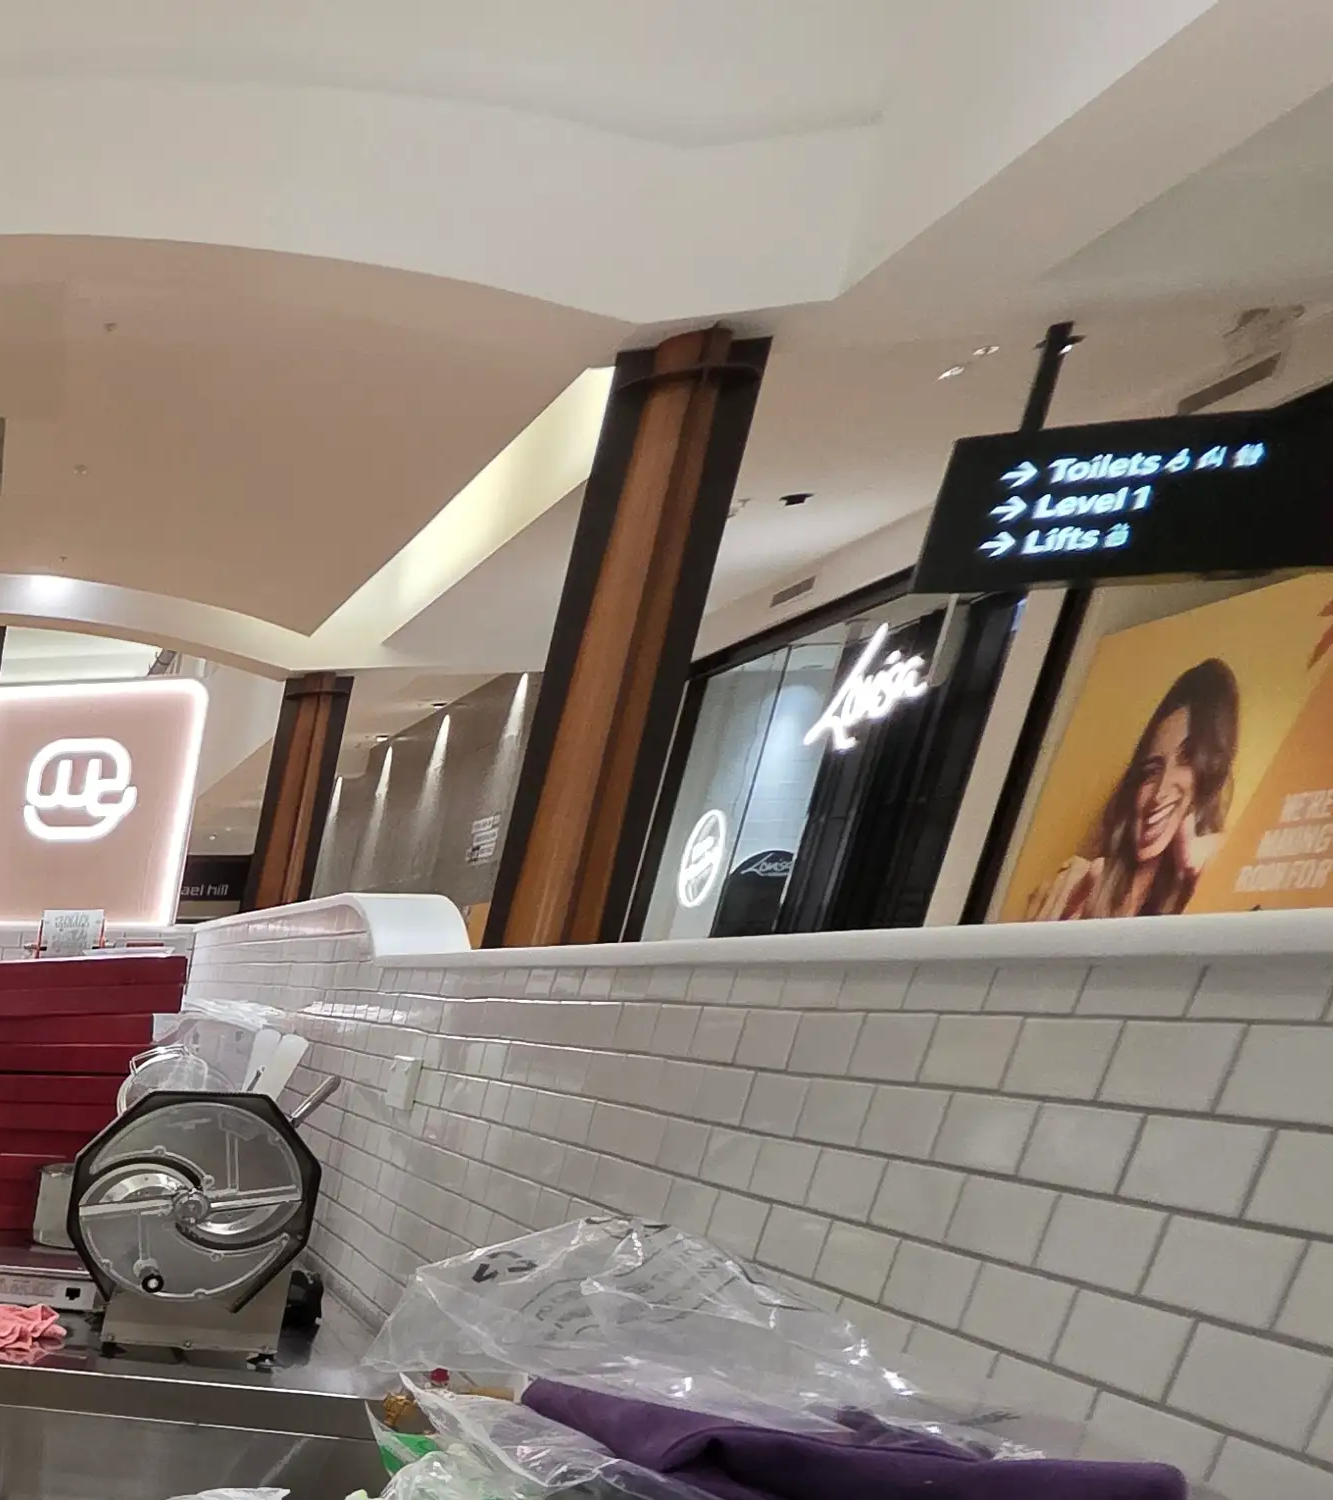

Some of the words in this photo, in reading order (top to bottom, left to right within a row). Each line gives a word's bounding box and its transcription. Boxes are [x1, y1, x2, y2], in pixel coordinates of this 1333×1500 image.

[1046, 452, 1162, 484] Toilets
[1032, 486, 1130, 519] Level
[1132, 485, 1153, 512] 1
[1020, 525, 1100, 555] Lifts
[206, 884, 229, 896] hill
